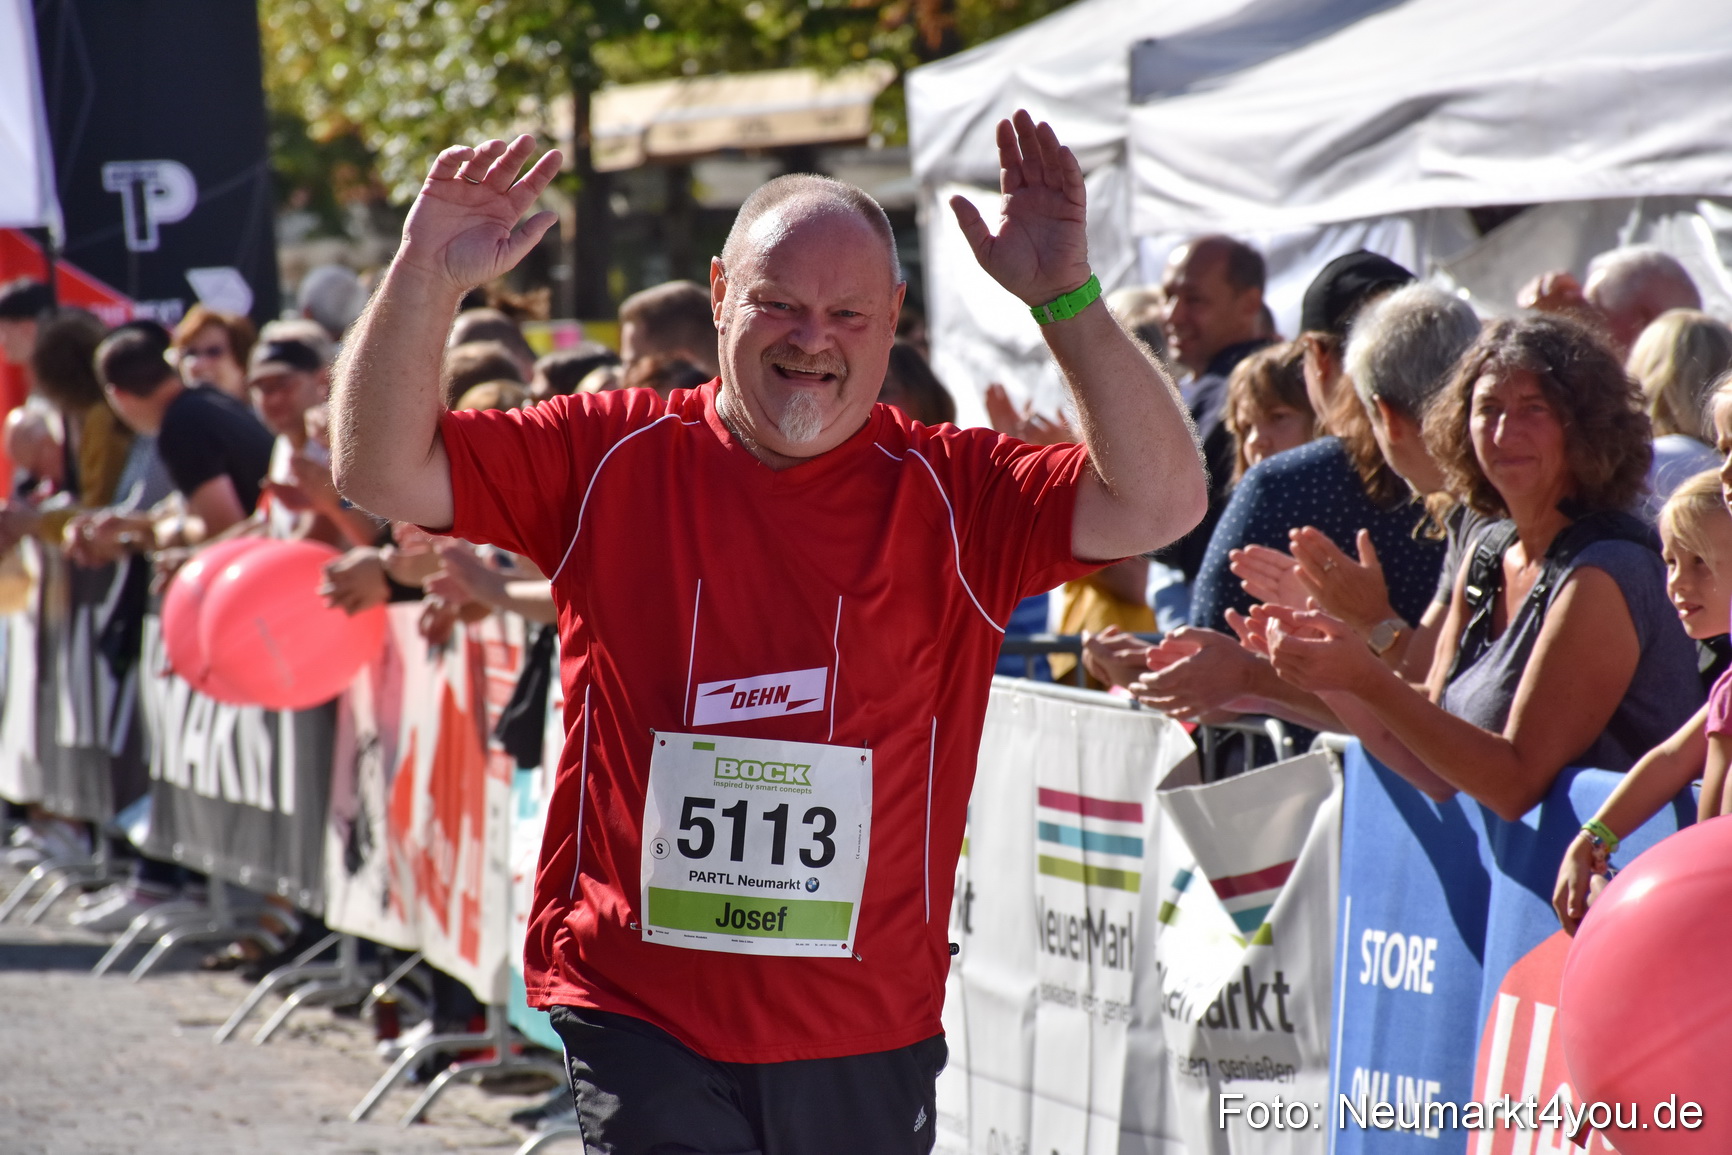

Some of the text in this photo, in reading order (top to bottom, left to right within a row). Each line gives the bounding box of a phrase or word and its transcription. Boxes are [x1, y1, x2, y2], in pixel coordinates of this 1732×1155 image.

[730, 684, 791, 709] DEHN
[714, 757, 812, 786] BOCK
[713, 780, 813, 795] inspired by smart concepts
[677, 796, 837, 868] 5113
[655, 842, 664, 855] S
[689, 870, 801, 890] PARTL Neumarkt
[715, 902, 788, 931] Josef
[1360, 927, 1438, 995] STORE
